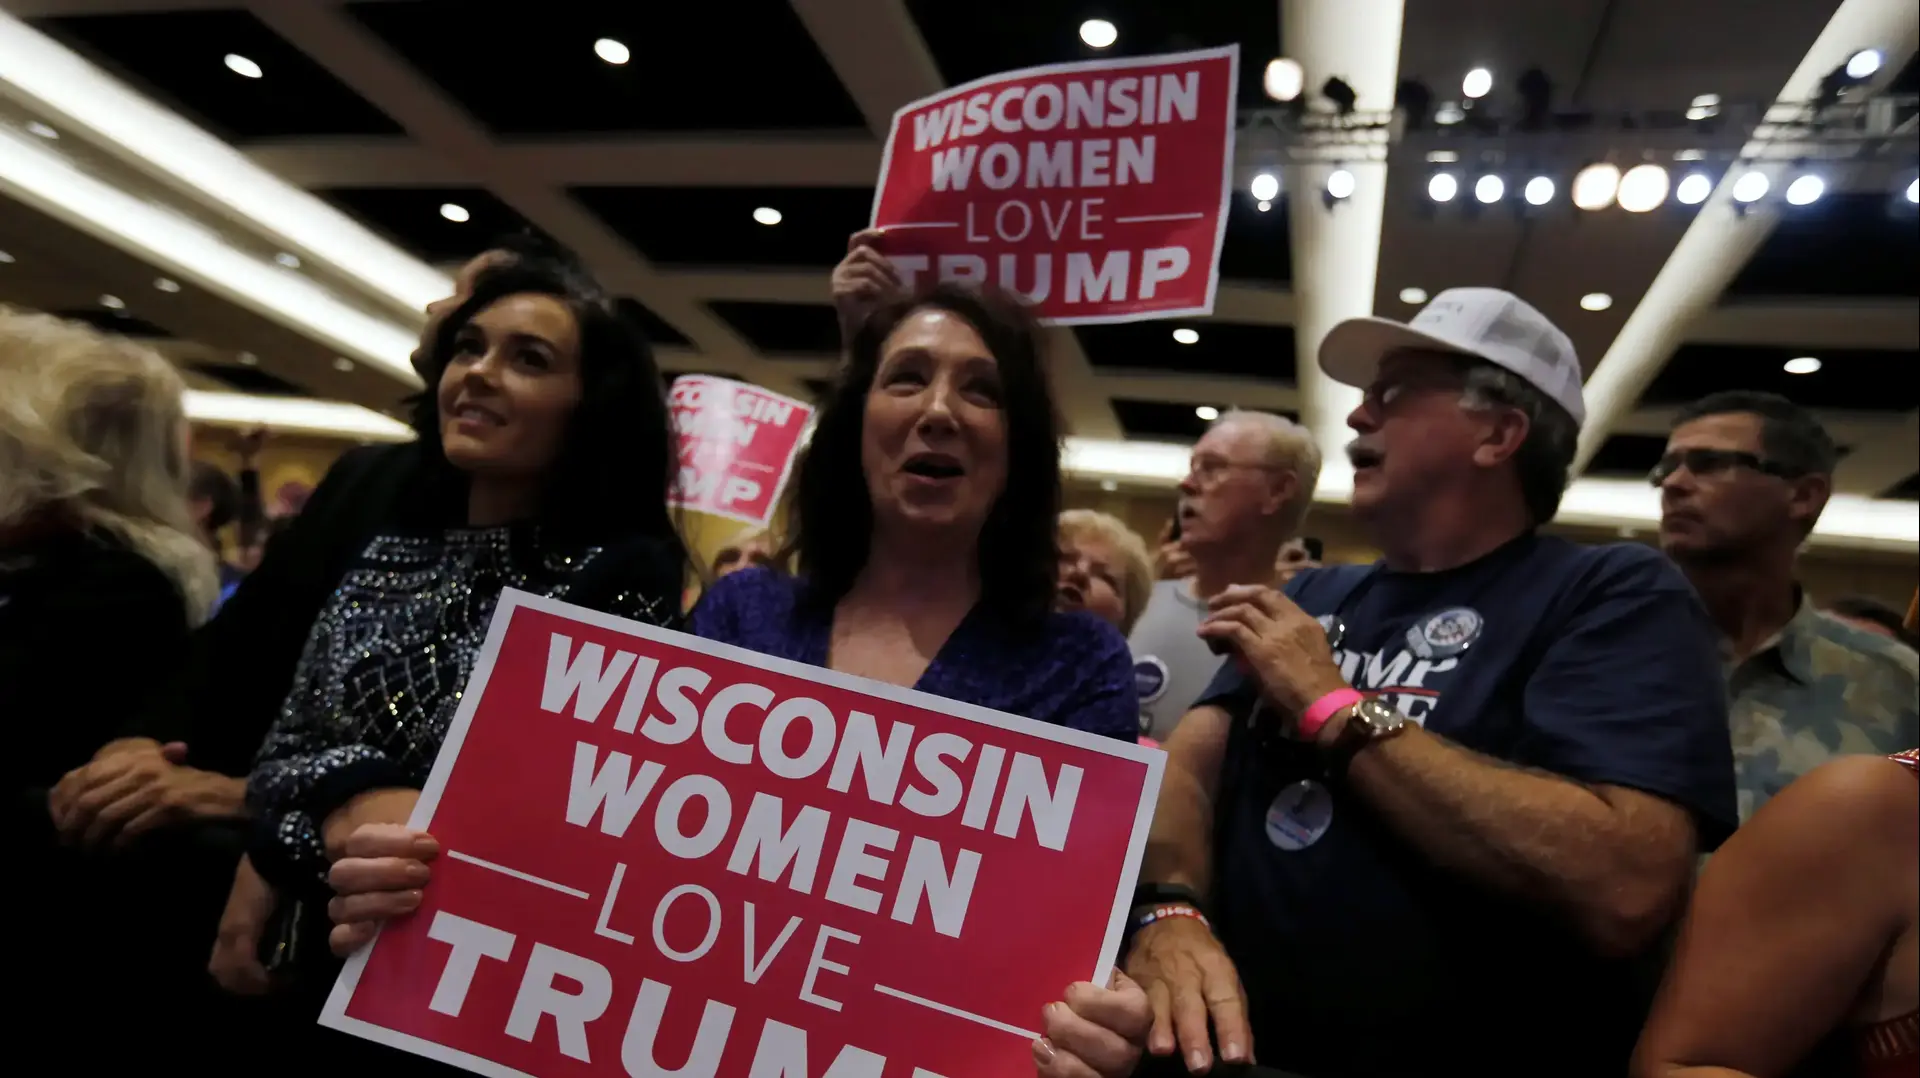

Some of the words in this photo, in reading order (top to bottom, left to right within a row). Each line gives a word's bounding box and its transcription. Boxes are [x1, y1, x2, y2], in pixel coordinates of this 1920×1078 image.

[913, 71, 1200, 151] WISCONSIN
[931, 135, 1157, 192] WOMEN
[967, 198, 1105, 242] LOVE
[540, 632, 1084, 852] WISCONSIN
[564, 741, 983, 939] WOMEN
[426, 910, 950, 1078] TRUM
[594, 862, 862, 1012] LOVE
